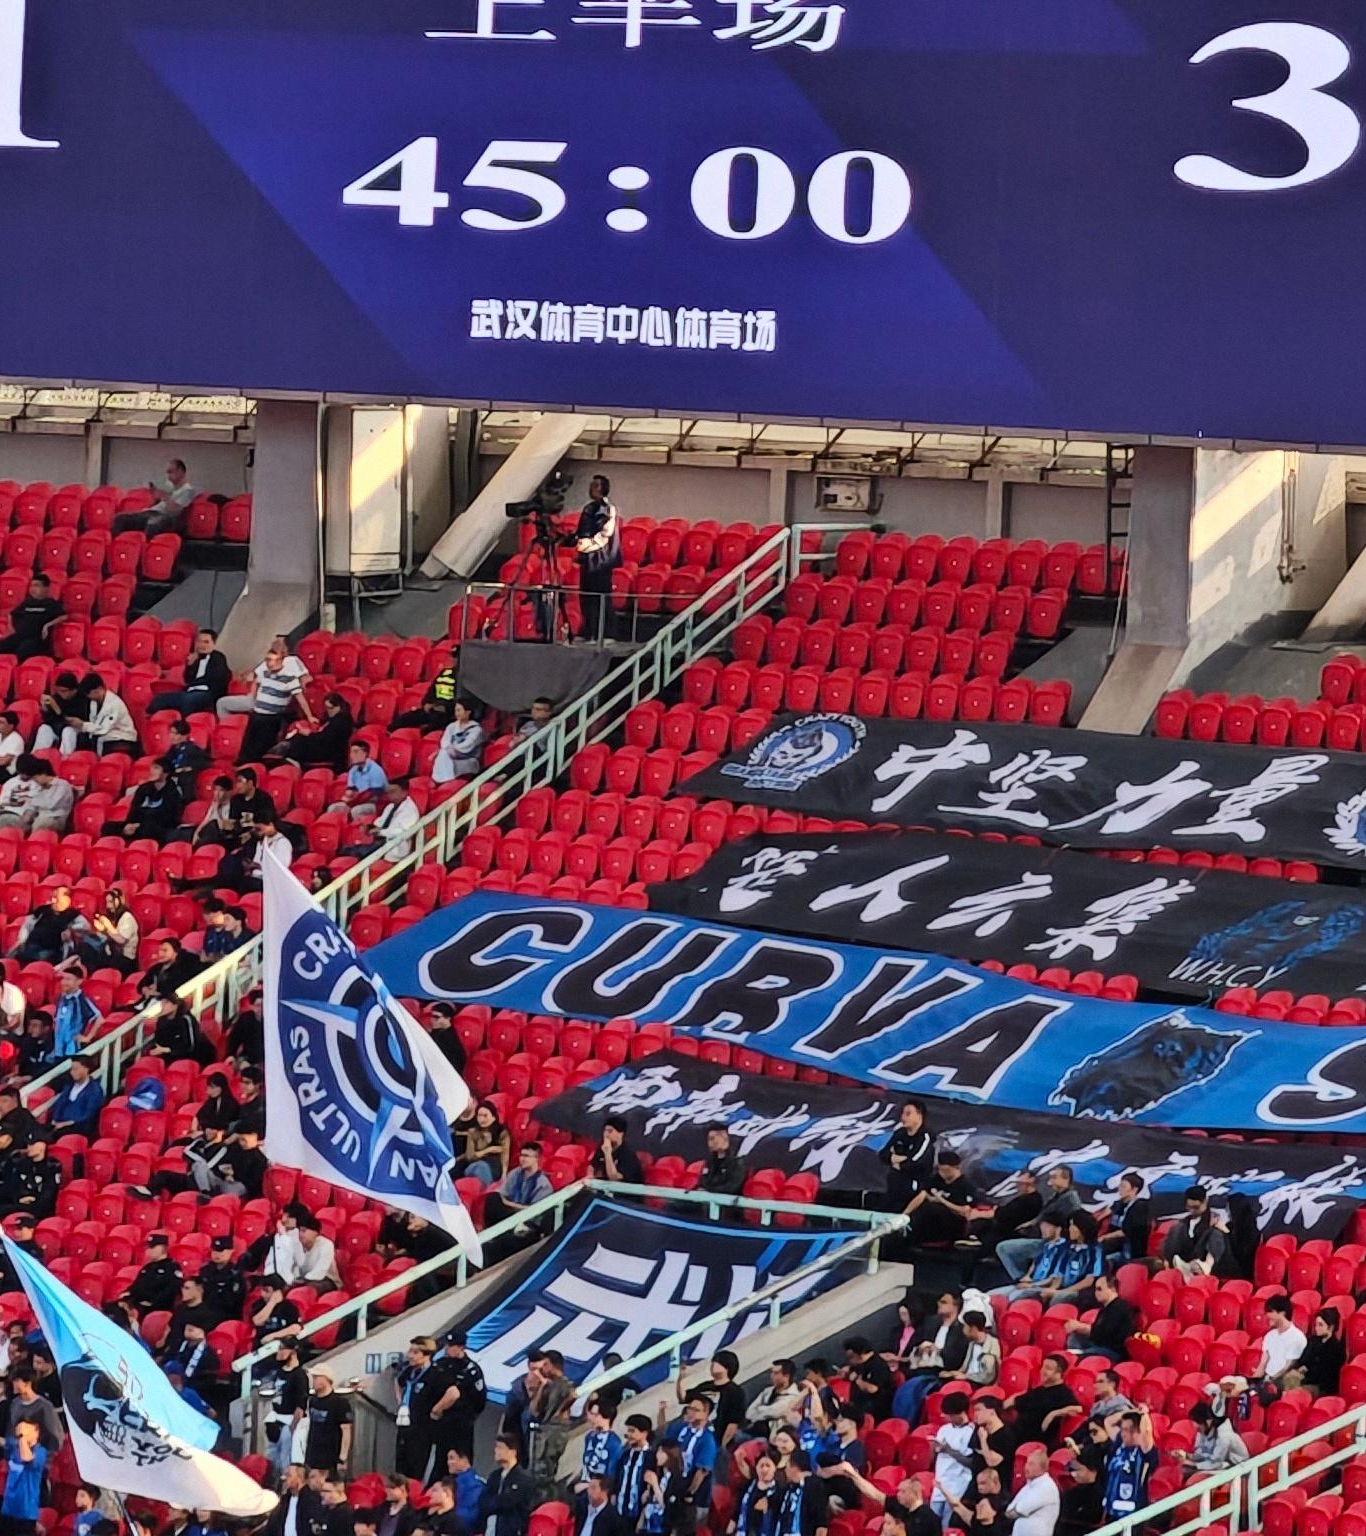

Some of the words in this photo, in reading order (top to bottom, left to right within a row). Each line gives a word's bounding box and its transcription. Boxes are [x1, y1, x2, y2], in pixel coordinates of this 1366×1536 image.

[1172, 22, 1361, 191] 3
[341, 136, 913, 246] 45:00
[469, 298, 777, 352] 武汉体育中心体育场
[870, 728, 1331, 843] 中坚力量
[419, 906, 1072, 1105] CURVA
[287, 1025, 362, 1164] ULTRAS
